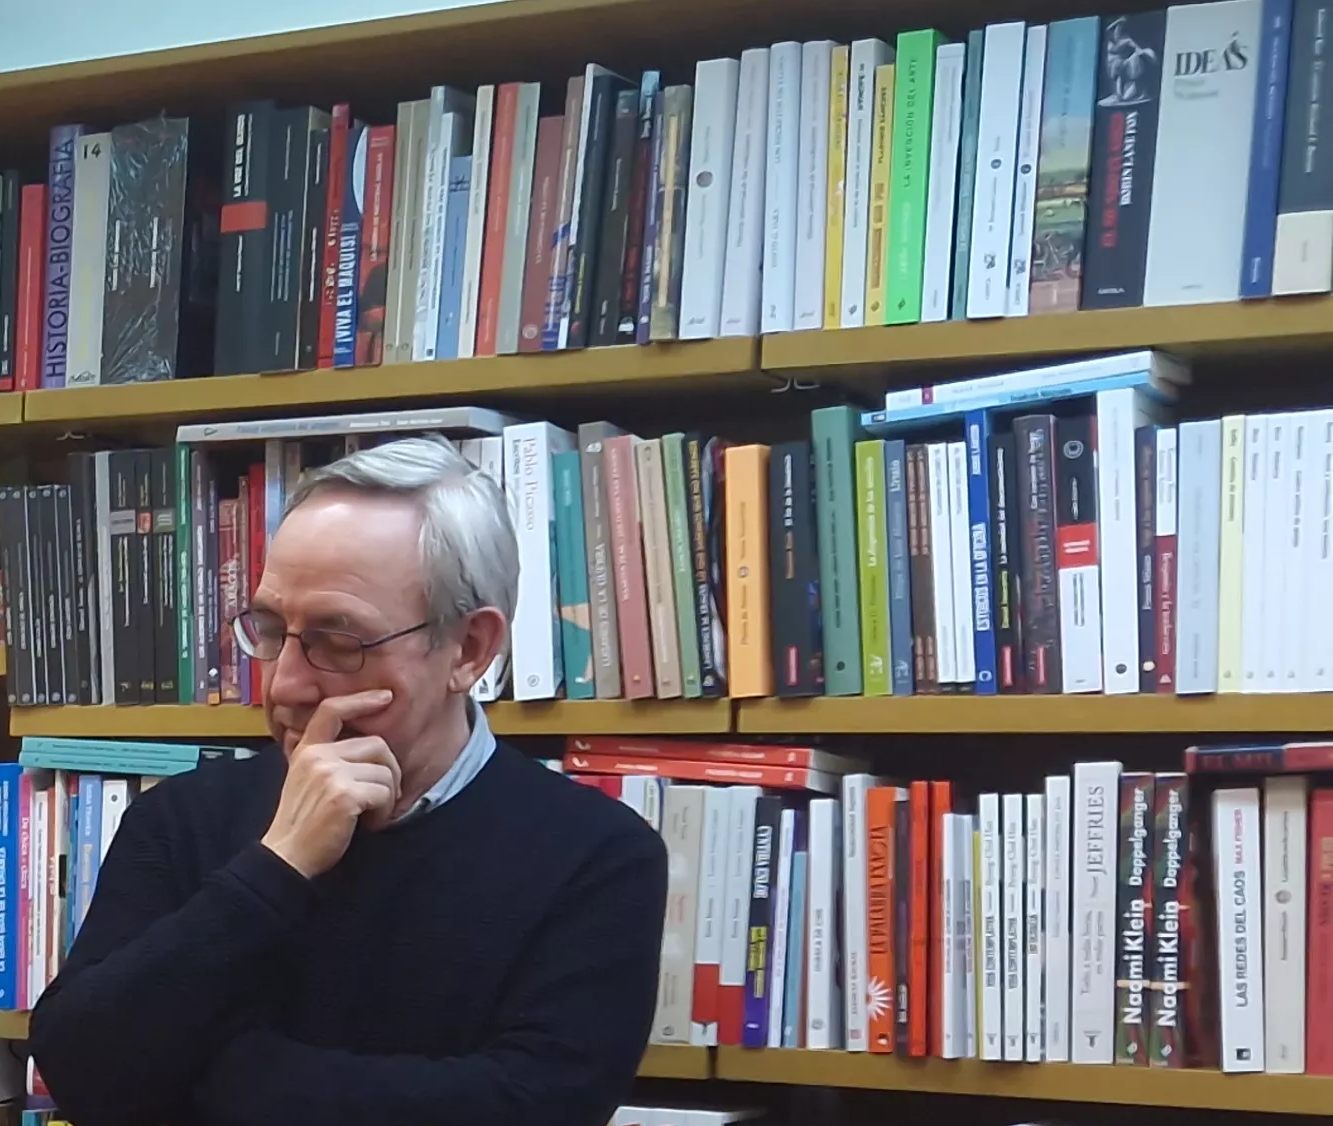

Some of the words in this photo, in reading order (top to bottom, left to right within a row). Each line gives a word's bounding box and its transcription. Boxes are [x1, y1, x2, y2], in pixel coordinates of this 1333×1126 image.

[83, 143, 102, 160] 14
[336, 290, 353, 306] EL
[523, 437, 538, 477] Pablo
[524, 481, 538, 531] Picasso
[1085, 785, 1106, 876] JEFFRIES
[1129, 787, 1148, 887] Doppelganger
[1163, 788, 1183, 888] Doppelganger
[1234, 870, 1246, 906] CAOS
[1123, 899, 1144, 953] Klein
[1158, 901, 1179, 954] Klein
[1234, 908, 1246, 934] DEL
[1235, 936, 1247, 979] REDES
[1123, 954, 1143, 1025] Naomi
[1157, 956, 1177, 1027] Naomi
[1235, 982, 1248, 1007] LAS
